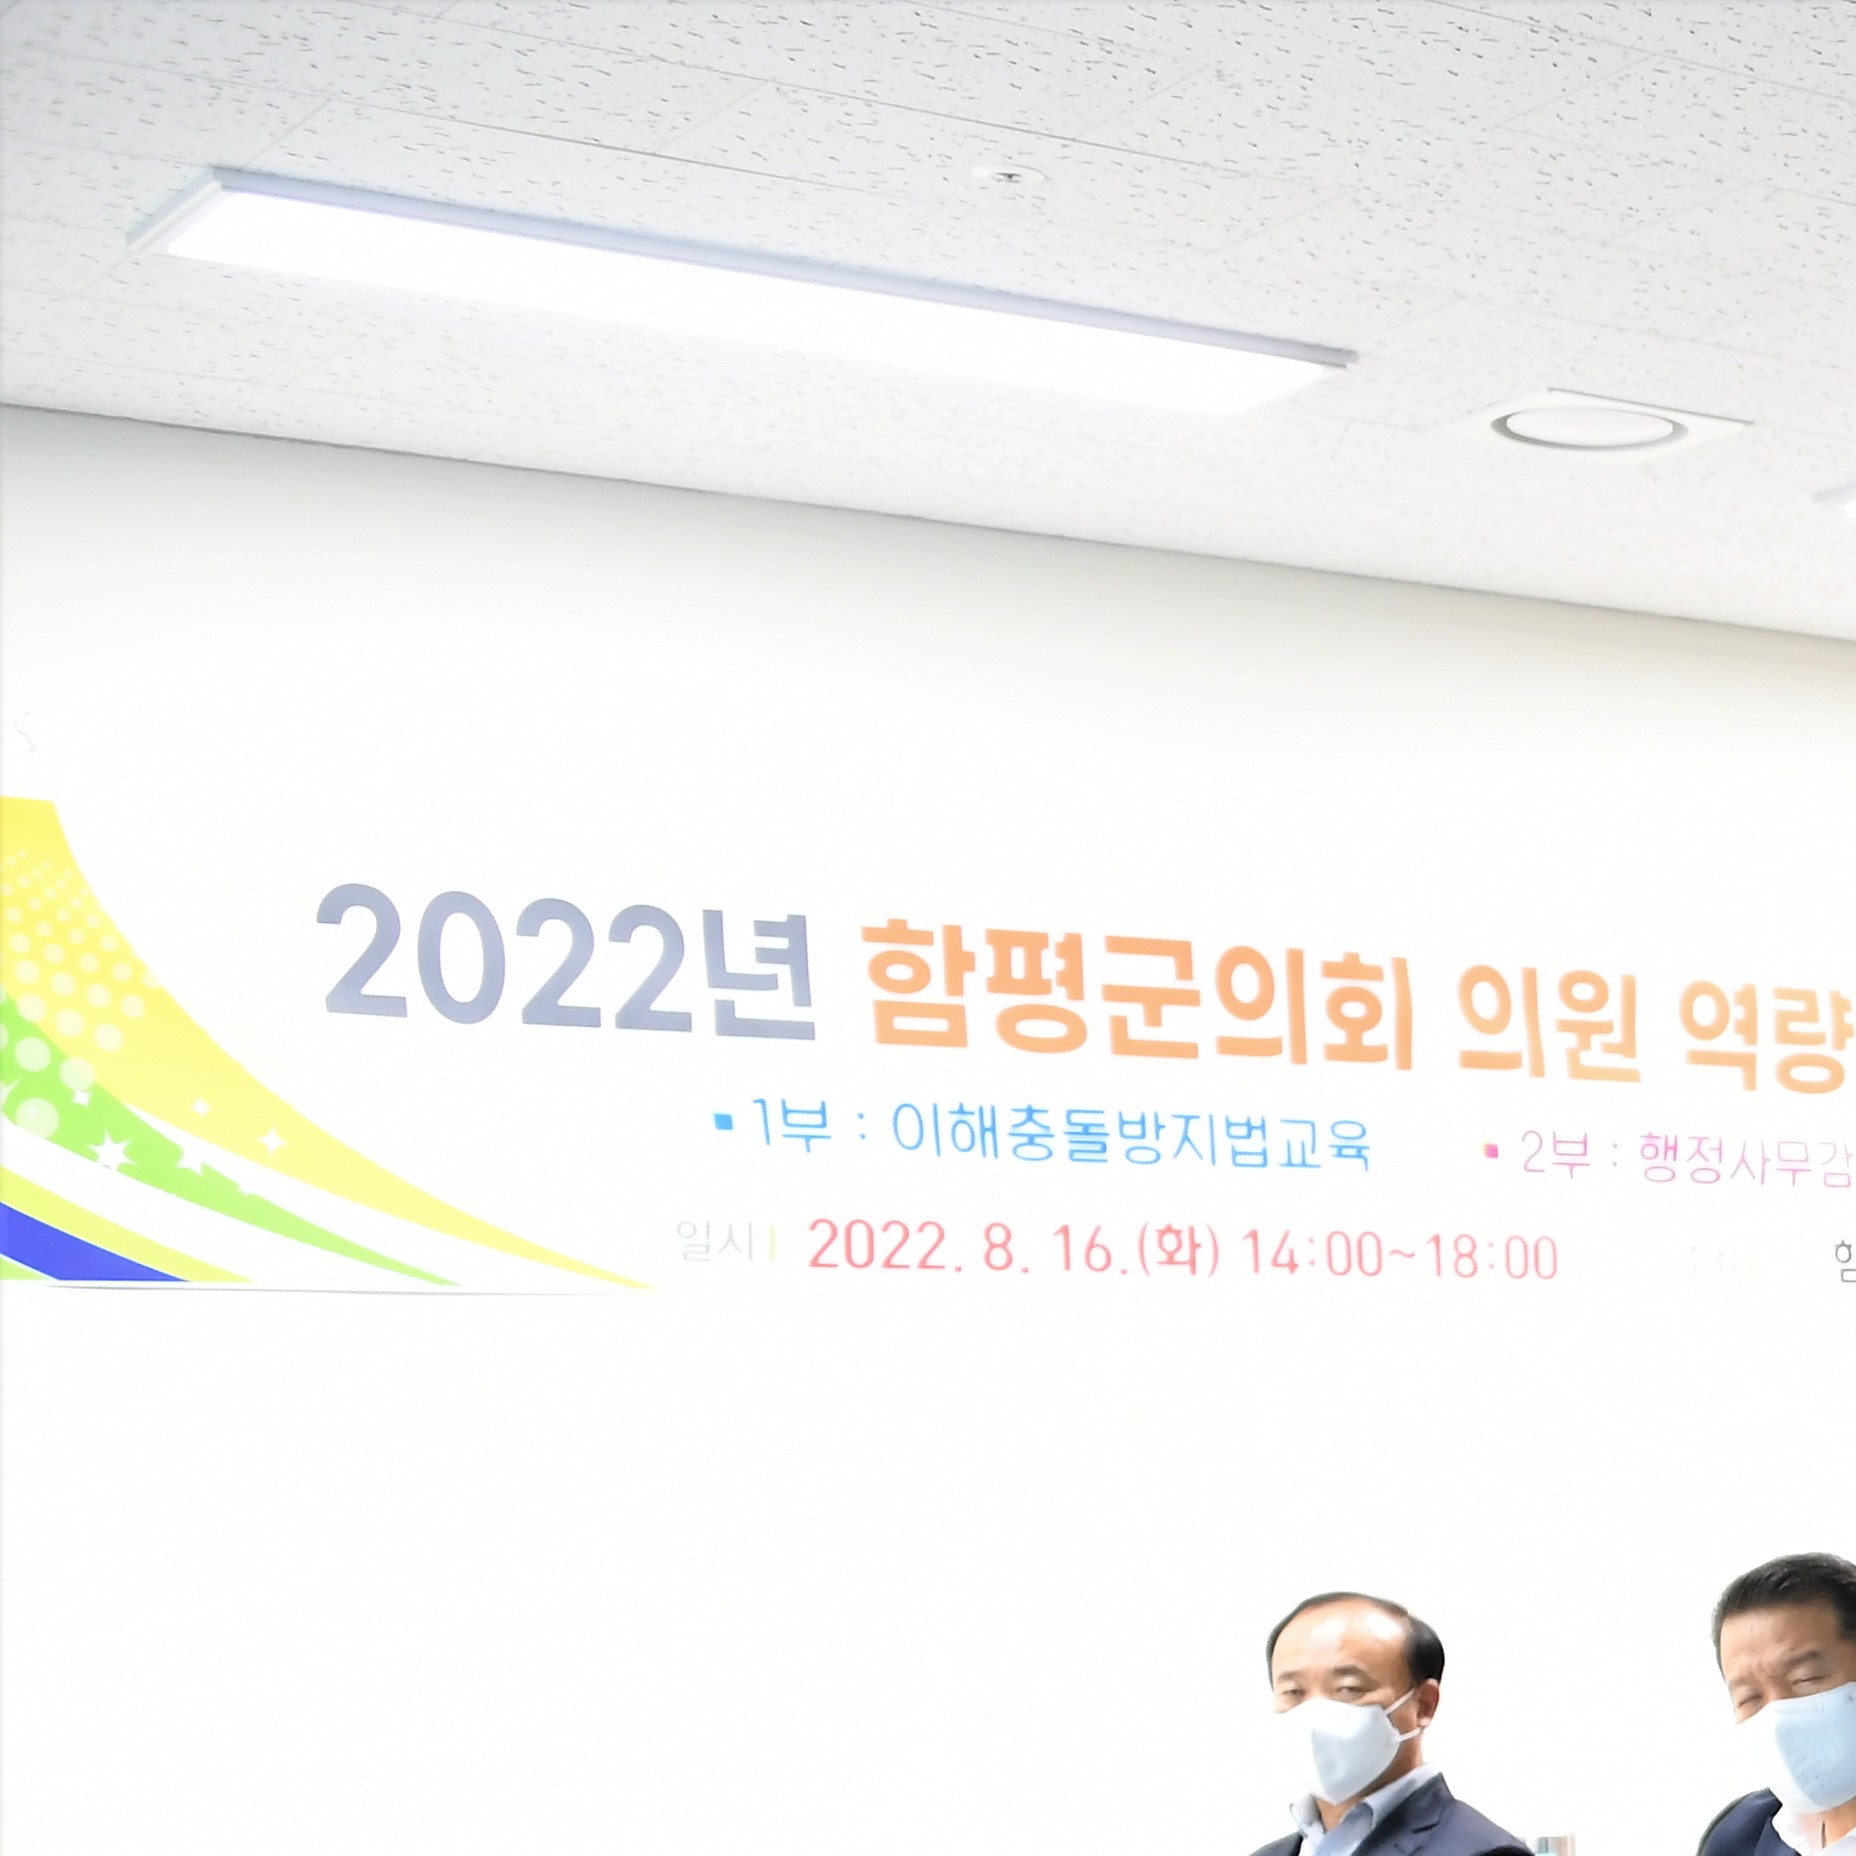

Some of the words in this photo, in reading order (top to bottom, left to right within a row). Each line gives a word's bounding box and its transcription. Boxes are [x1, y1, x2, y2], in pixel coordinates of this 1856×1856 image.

[316, 882, 817, 1041] 2022년
[860, 916, 1415, 1072] 함평군의회
[1457, 963, 1642, 1084] 의원
[752, 1096, 832, 1153] 1부
[892, 1100, 1371, 1172] 이해충돌방지법교육
[1521, 1130, 1590, 1179] 2부
[676, 1220, 753, 1262] 일시
[807, 1218, 962, 1273] 2022.
[983, 1221, 1030, 1274] 8.
[1053, 1222, 1220, 1278] 16.(화)
[1243, 1227, 1559, 1280] 14:00~18:00
